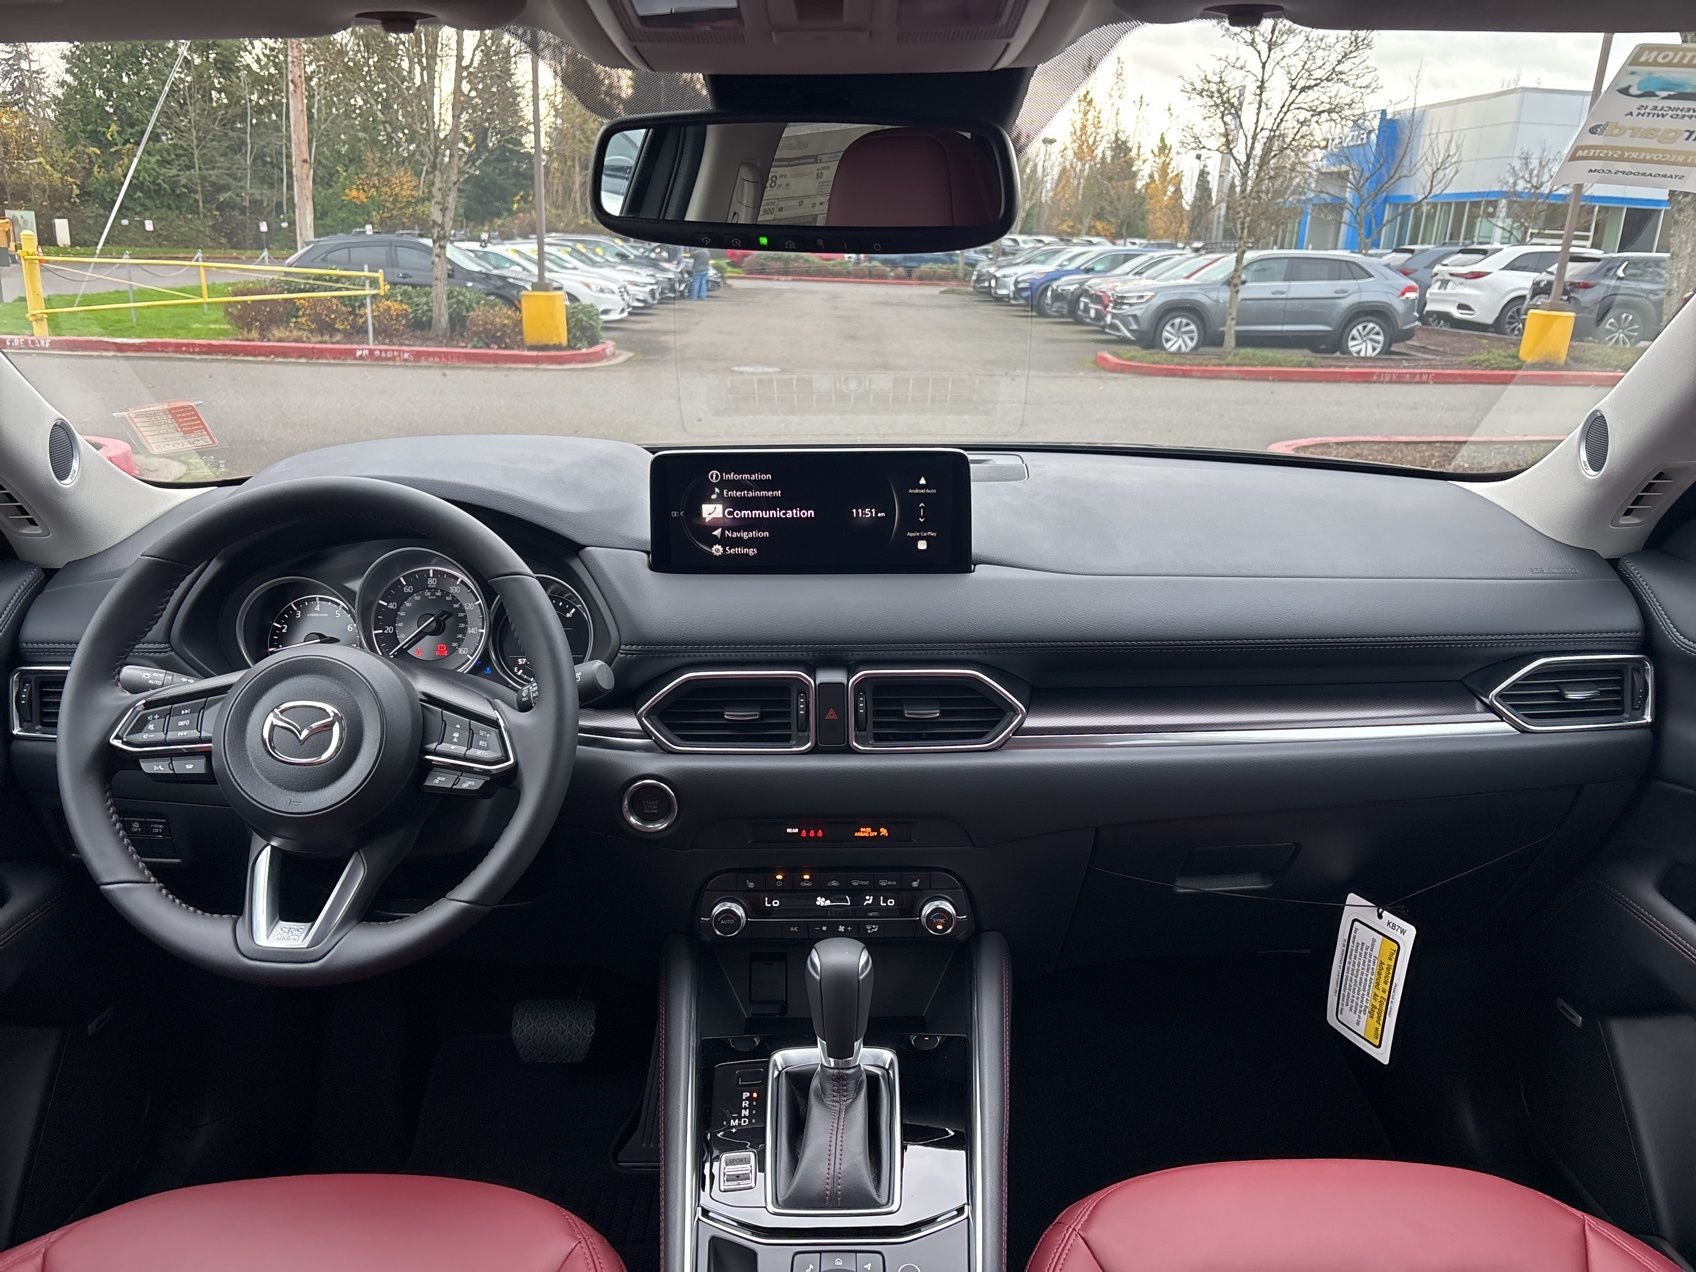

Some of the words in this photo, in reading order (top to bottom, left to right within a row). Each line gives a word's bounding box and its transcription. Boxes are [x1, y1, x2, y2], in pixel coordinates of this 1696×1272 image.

[722, 472, 772, 480] Information
[724, 508, 814, 518] Communication
[852, 508, 876, 518] 11:51
[724, 530, 769, 540] Navigation
[726, 546, 758, 556] Settings
[336, 610, 341, 618] 5
[347, 624, 353, 632] 6
[764, 897, 780, 907] Lo
[880, 896, 895, 906] Lo
[280, 926, 305, 936] SRS
[1387, 920, 1407, 936] KB7W
[1387, 947, 1395, 962] This
[1374, 959, 1384, 990] Advanced
[1383, 962, 1392, 986] Vehicle
[1381, 986, 1387, 995] is
[1367, 1002, 1376, 1020] Bags
[1374, 994, 1386, 1026] Equipped
